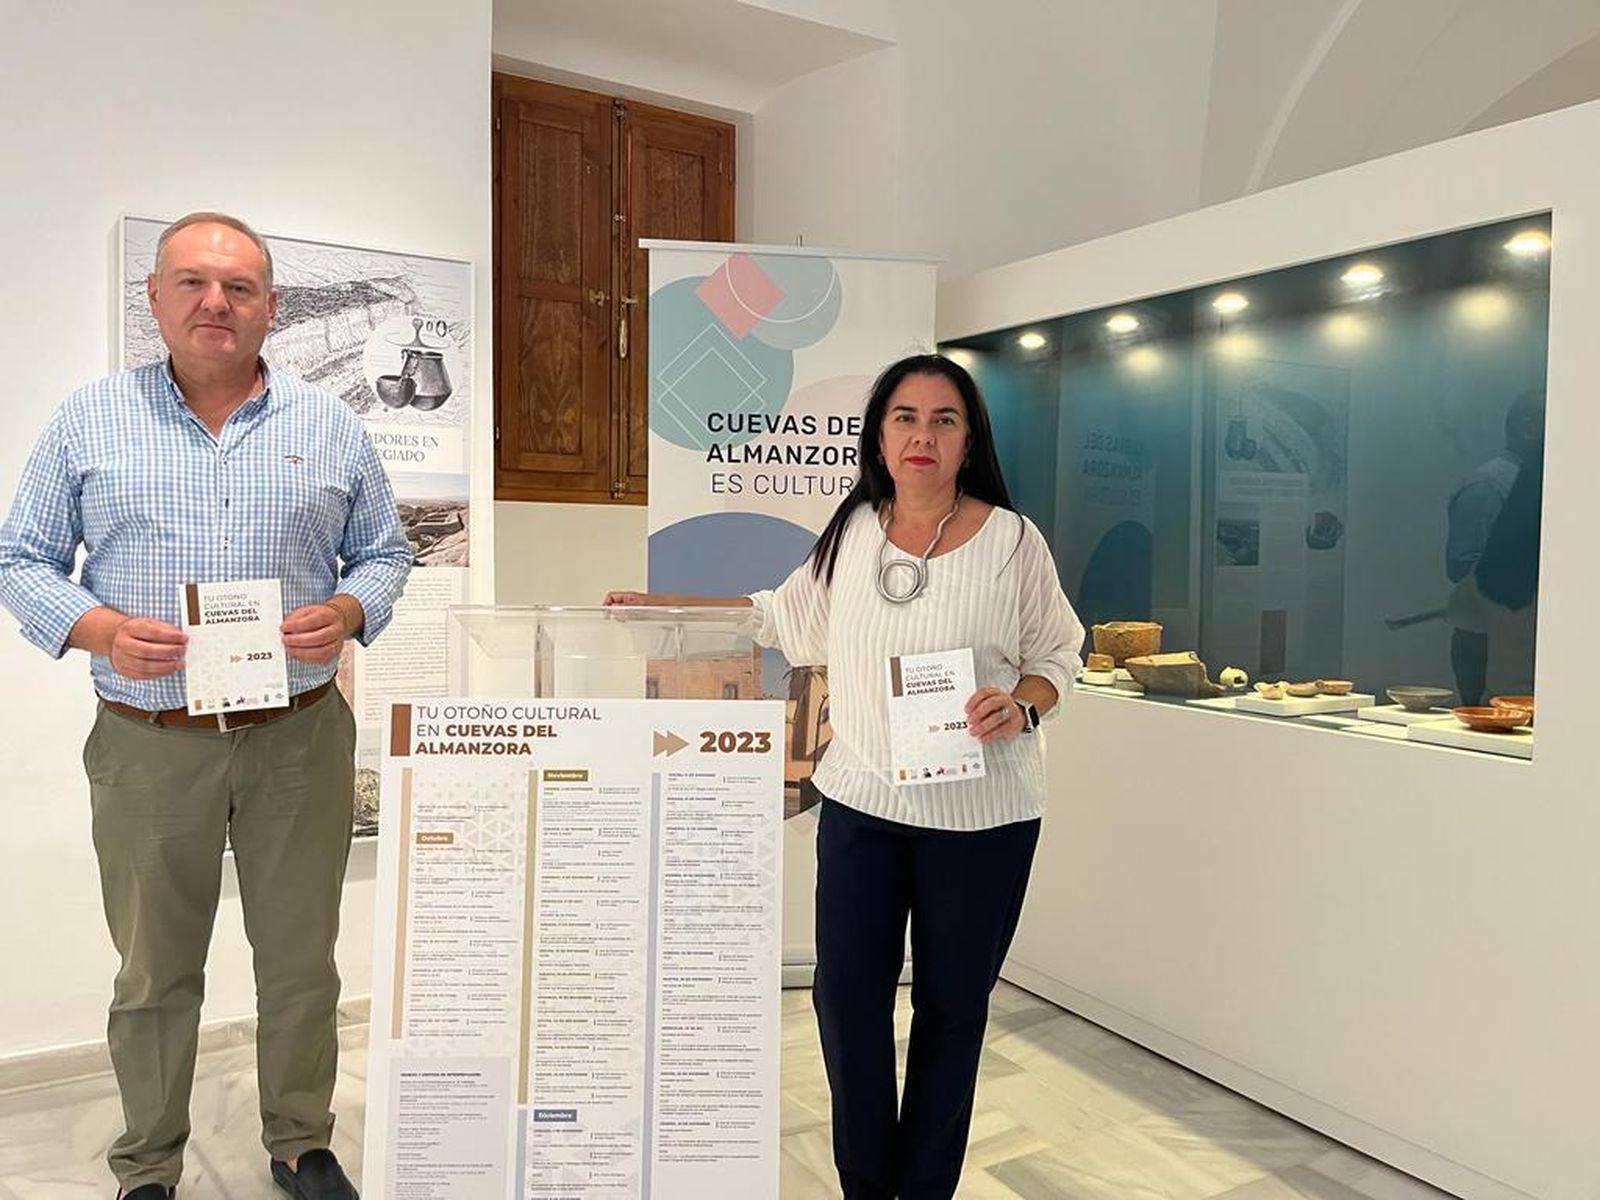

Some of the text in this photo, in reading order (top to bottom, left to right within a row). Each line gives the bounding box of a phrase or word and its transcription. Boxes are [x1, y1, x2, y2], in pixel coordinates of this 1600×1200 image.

[707, 412, 861, 436] CUEVAS DE
[367, 433, 439, 447] ADORES EN
[375, 449, 426, 462] EGIADO
[706, 444, 858, 466] ALMANZOR
[712, 473, 854, 496] ES CULTUR
[204, 602, 247, 610] CULTURAL
[204, 609, 239, 617] CUEVAS
[205, 616, 260, 625] ALMANZORA
[247, 652, 272, 660] 2023
[906, 680, 936, 688] CUEVAS
[907, 685, 955, 695] ALMANZORA
[417, 704, 601, 720] TU OTOÑO CULTURAL
[417, 724, 558, 738] EN CUEVAS DEL
[944, 721, 968, 730] 2023
[415, 742, 532, 755] ALMANZORA
[699, 731, 772, 754] 2023
[538, 1111, 572, 1119] Diciembre
